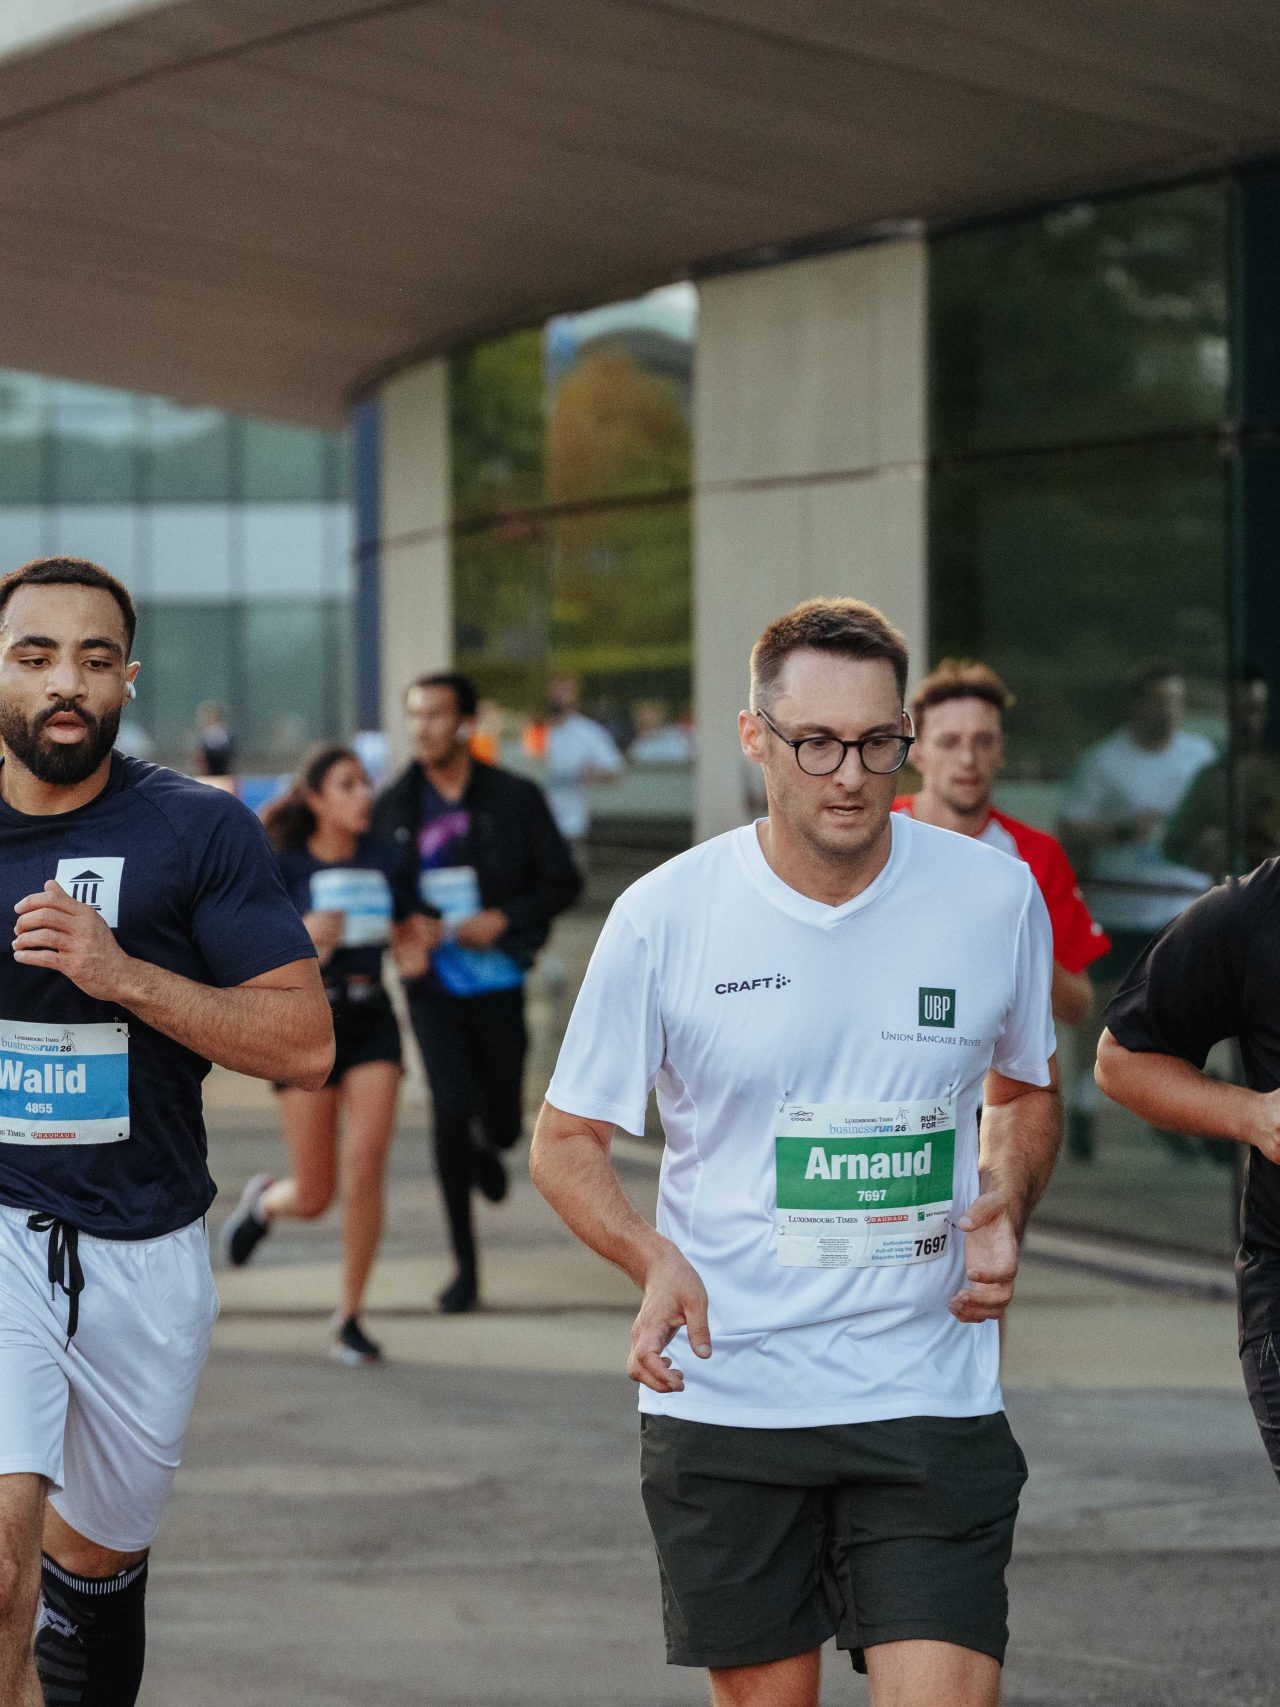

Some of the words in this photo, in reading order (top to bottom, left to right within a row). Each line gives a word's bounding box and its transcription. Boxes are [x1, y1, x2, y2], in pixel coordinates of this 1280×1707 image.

[715, 977, 773, 995] CRAFT
[924, 995, 951, 1021] UBP
[881, 1031, 914, 1042] UNION
[916, 1032, 957, 1045] BANCAIRE
[25, 1102, 53, 1114] 4855
[894, 1124, 907, 1132] 26
[921, 1122, 936, 1130] FOR
[7, 1129, 26, 1138] TIMES
[804, 1142, 932, 1180] Arnaud
[857, 1189, 887, 1202] 7697
[788, 1215, 835, 1224] LUXEMBOURG
[836, 1216, 858, 1224] TIMES
[871, 1214, 908, 1223] BAUHAUS
[914, 1234, 947, 1257] 7697
